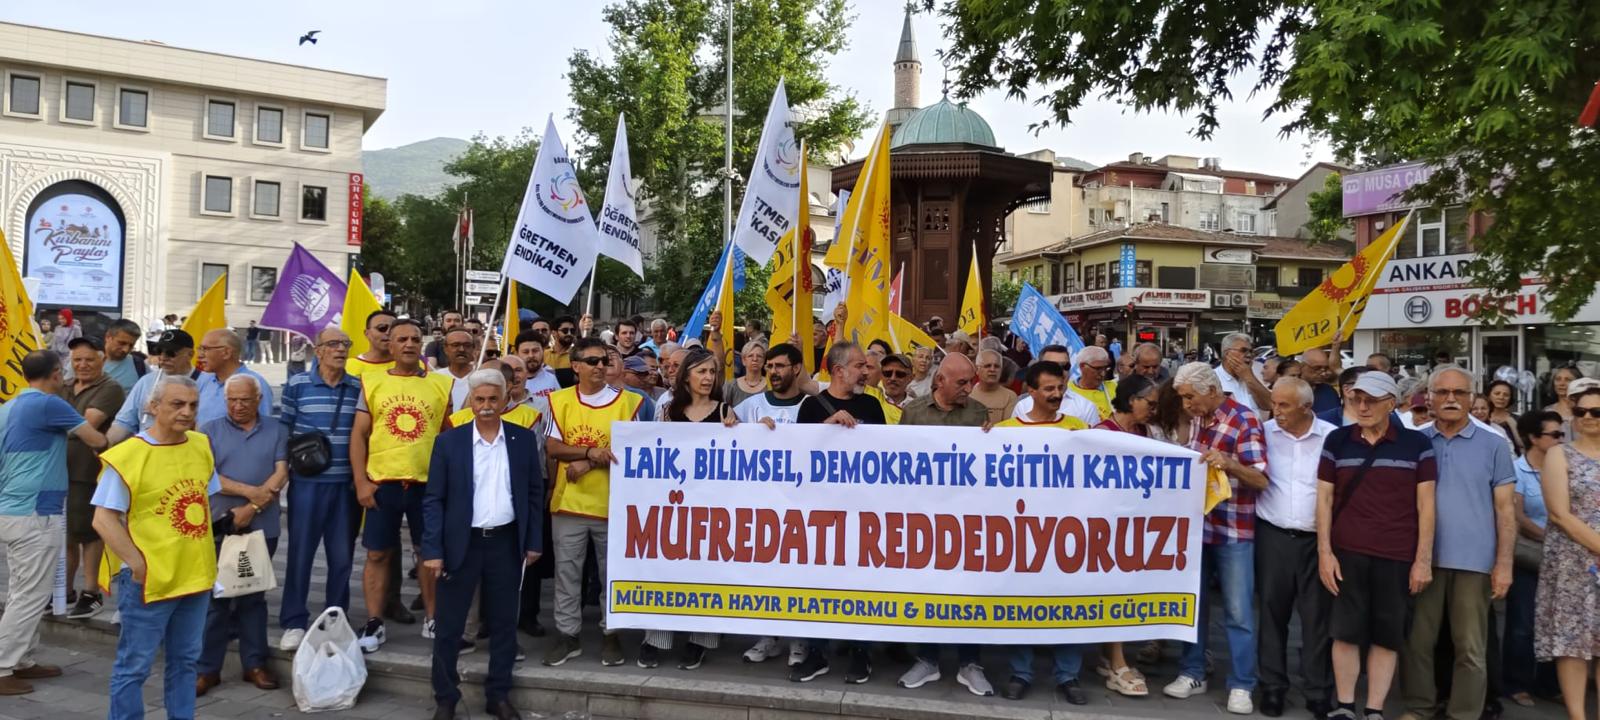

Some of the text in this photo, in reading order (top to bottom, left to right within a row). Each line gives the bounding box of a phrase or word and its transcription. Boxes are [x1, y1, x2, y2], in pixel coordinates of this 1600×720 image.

[1364, 173, 1401, 192] MUSA
[624, 437, 1193, 499] LAİK, BİLİMSEL, DEMOKRATİK EĞİTİM KARŞITI
[624, 489, 1190, 574] MÜFREDATI REDDEDİYORUZ!
[615, 586, 1188, 623] MÜFREDATA HAYIR PLATFORMU & BURSA DEMOKRASİ GÜÇLERİ
